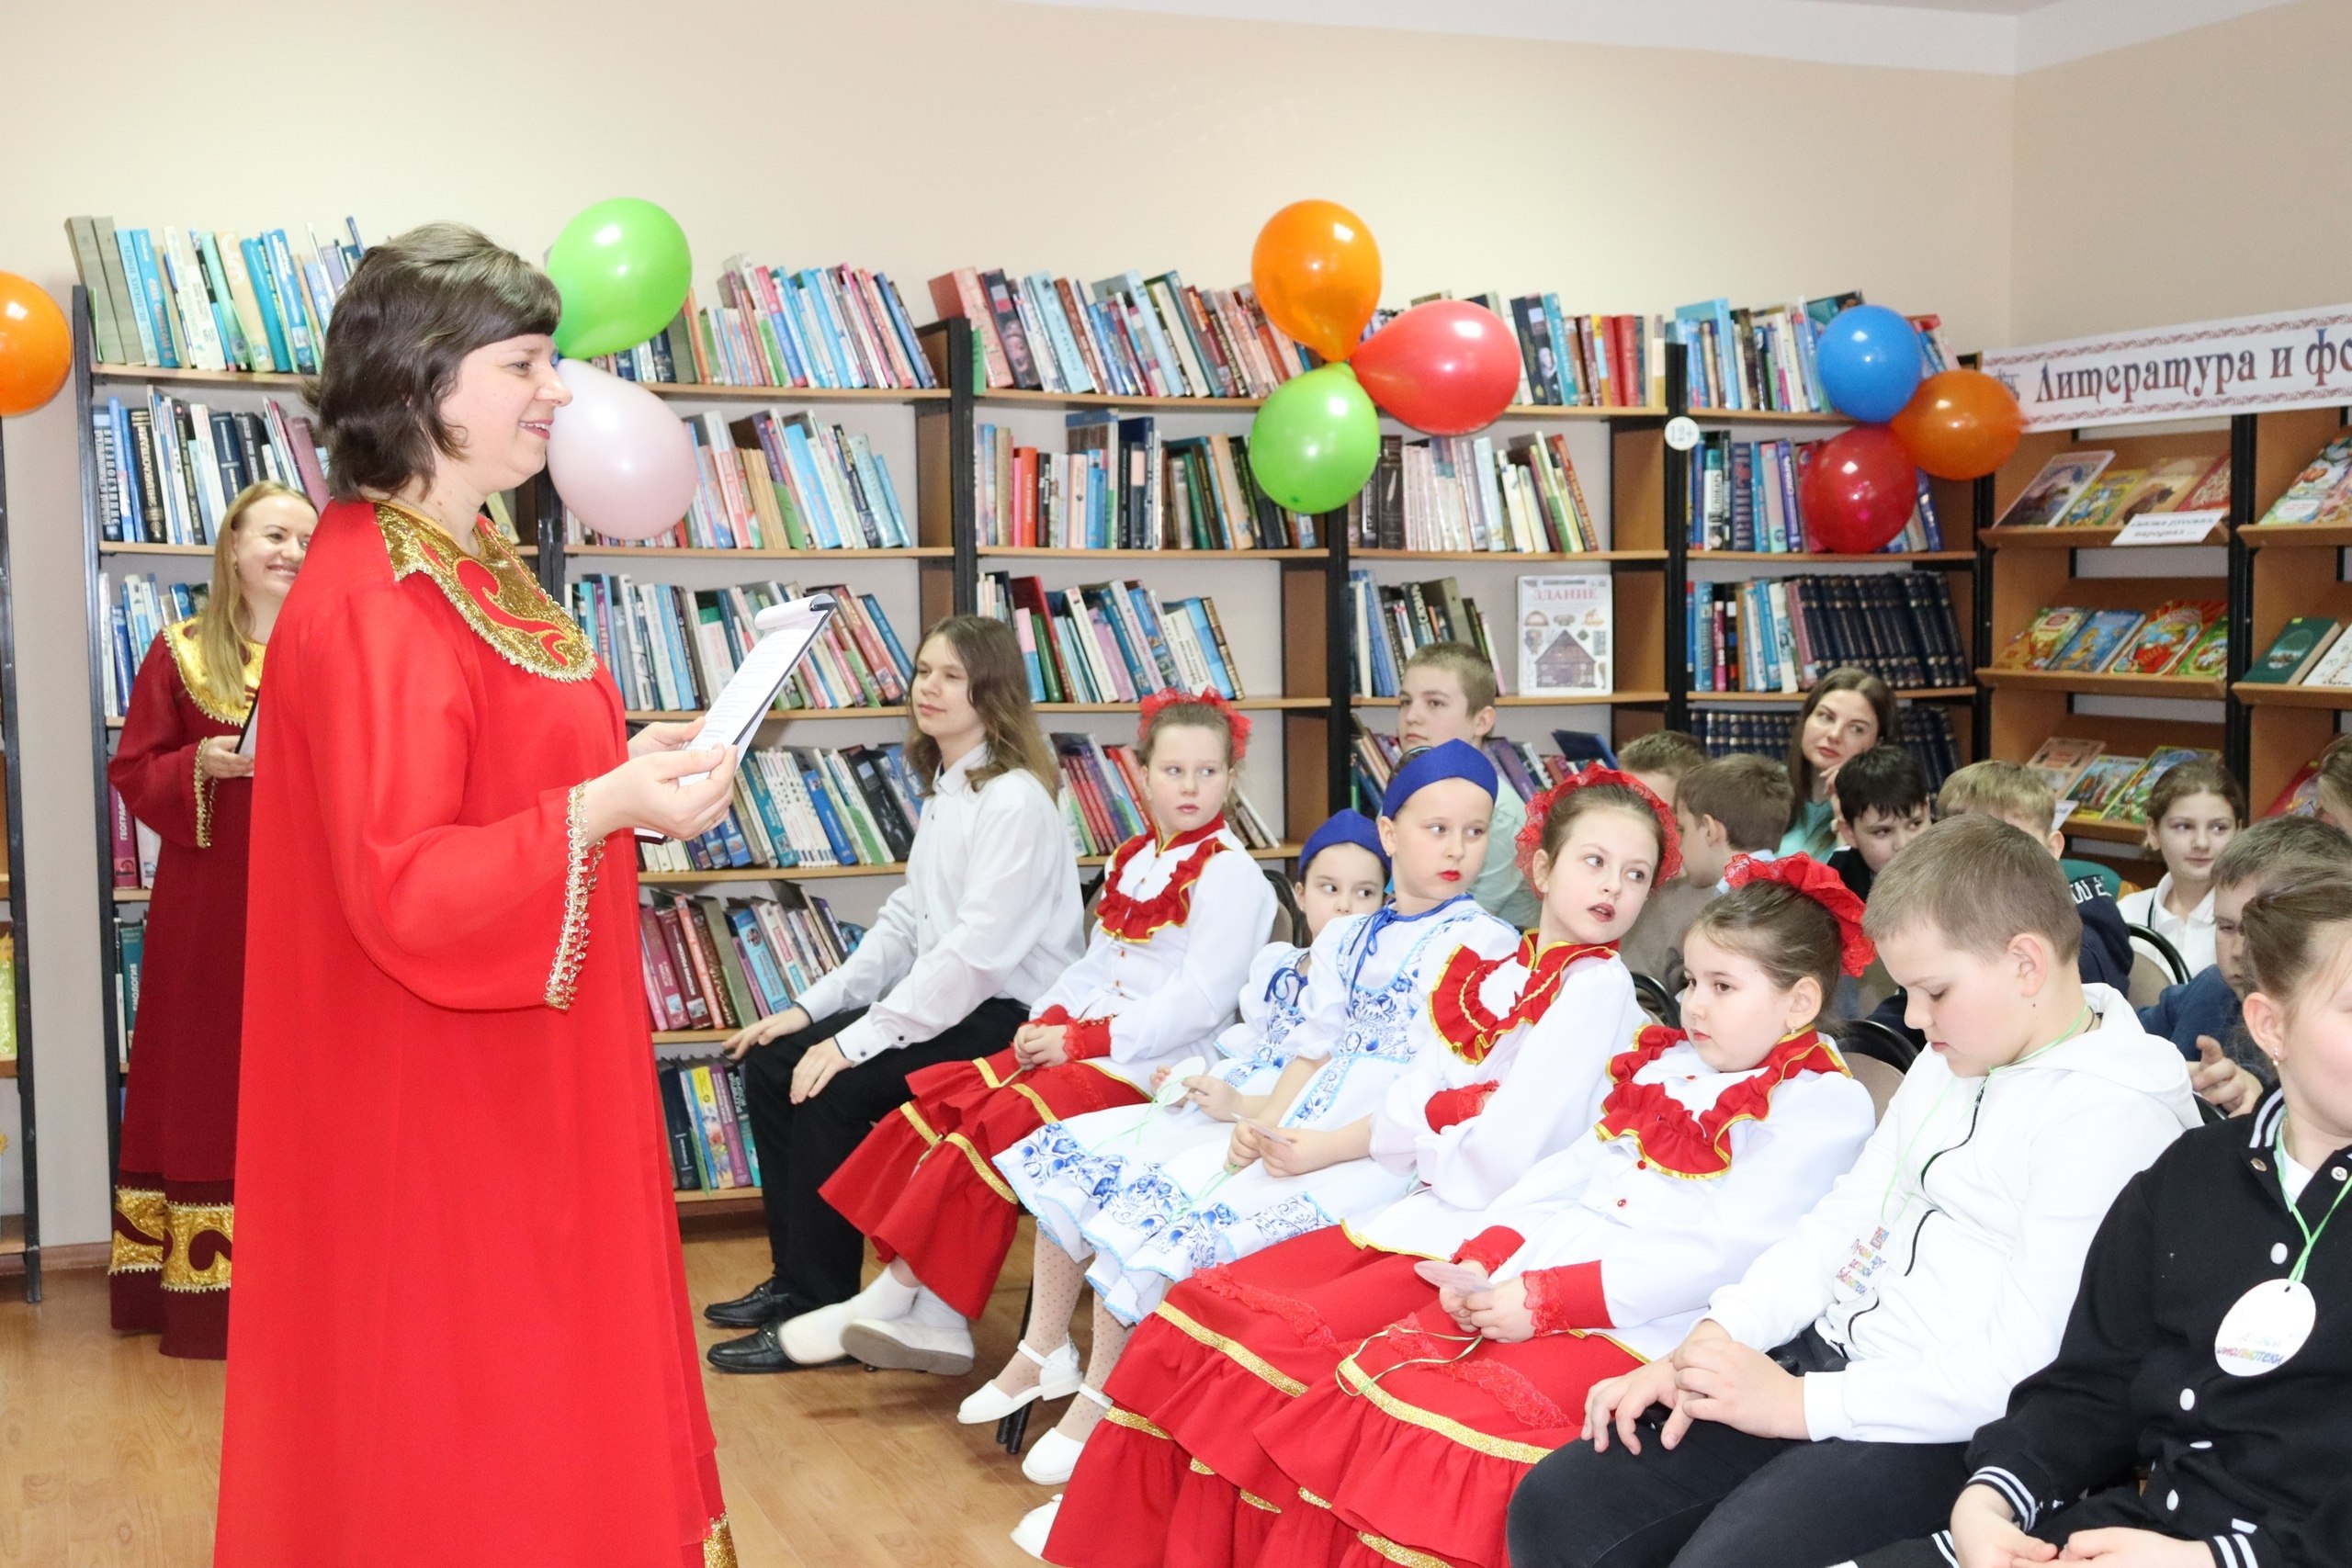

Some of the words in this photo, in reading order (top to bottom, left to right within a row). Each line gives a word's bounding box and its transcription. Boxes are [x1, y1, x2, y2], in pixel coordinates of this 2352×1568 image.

[2035, 350, 2256, 403] Литература
[2269, 345, 2301, 378] и
[137, 424, 157, 506] ЭНЦИКЛОПЕДИЯ
[1408, 582, 1430, 625] СЛОВАРЬ
[1533, 587, 1598, 602] ЗДАНИЕ
[675, 942, 687, 967] РОССИИ
[683, 966, 696, 996] ИСТОРИЯ
